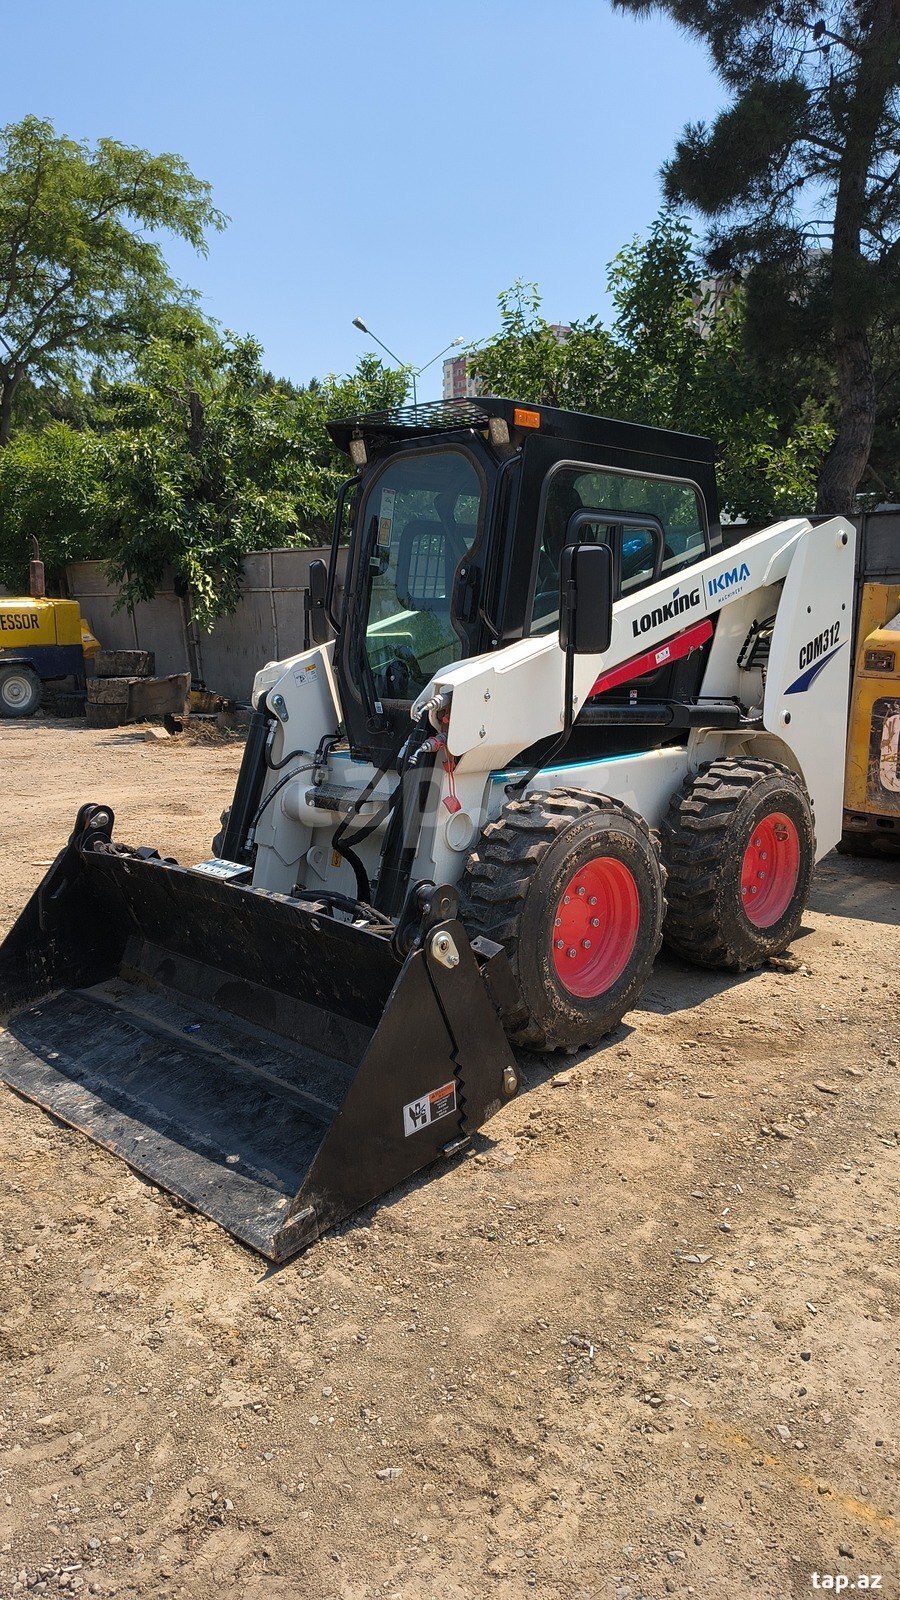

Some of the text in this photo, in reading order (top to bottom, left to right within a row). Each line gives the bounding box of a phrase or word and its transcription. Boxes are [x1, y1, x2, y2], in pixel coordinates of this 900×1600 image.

[707, 562, 751, 597] IKMA
[0, 613, 40, 630] ESSOR
[799, 620, 840, 670] CDM312
